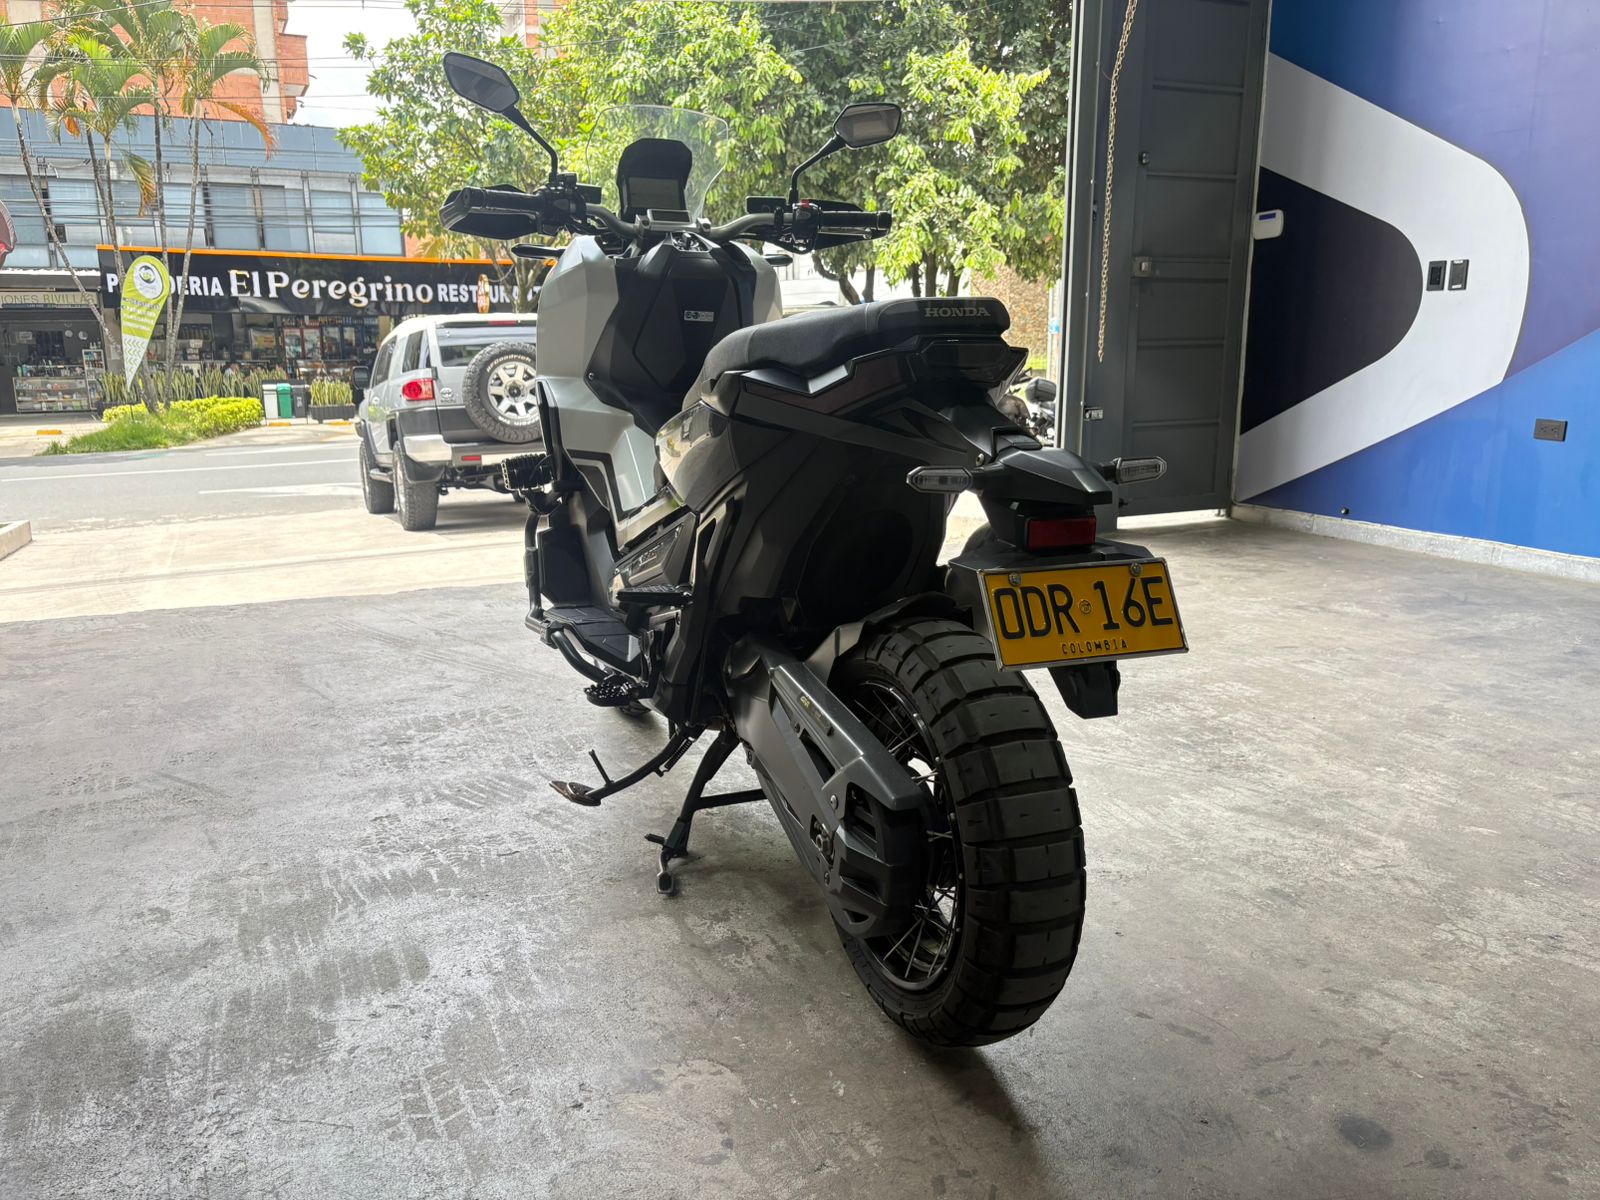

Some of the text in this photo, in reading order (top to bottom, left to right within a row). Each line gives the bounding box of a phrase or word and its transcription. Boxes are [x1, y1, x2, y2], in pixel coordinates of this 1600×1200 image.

[228, 269, 262, 298] El
[266, 270, 434, 308] Peregrino
[924, 307, 991, 318] HONDA
[992, 576, 1173, 640] ODR 16E
[1061, 638, 1129, 655] COLOMBIA
